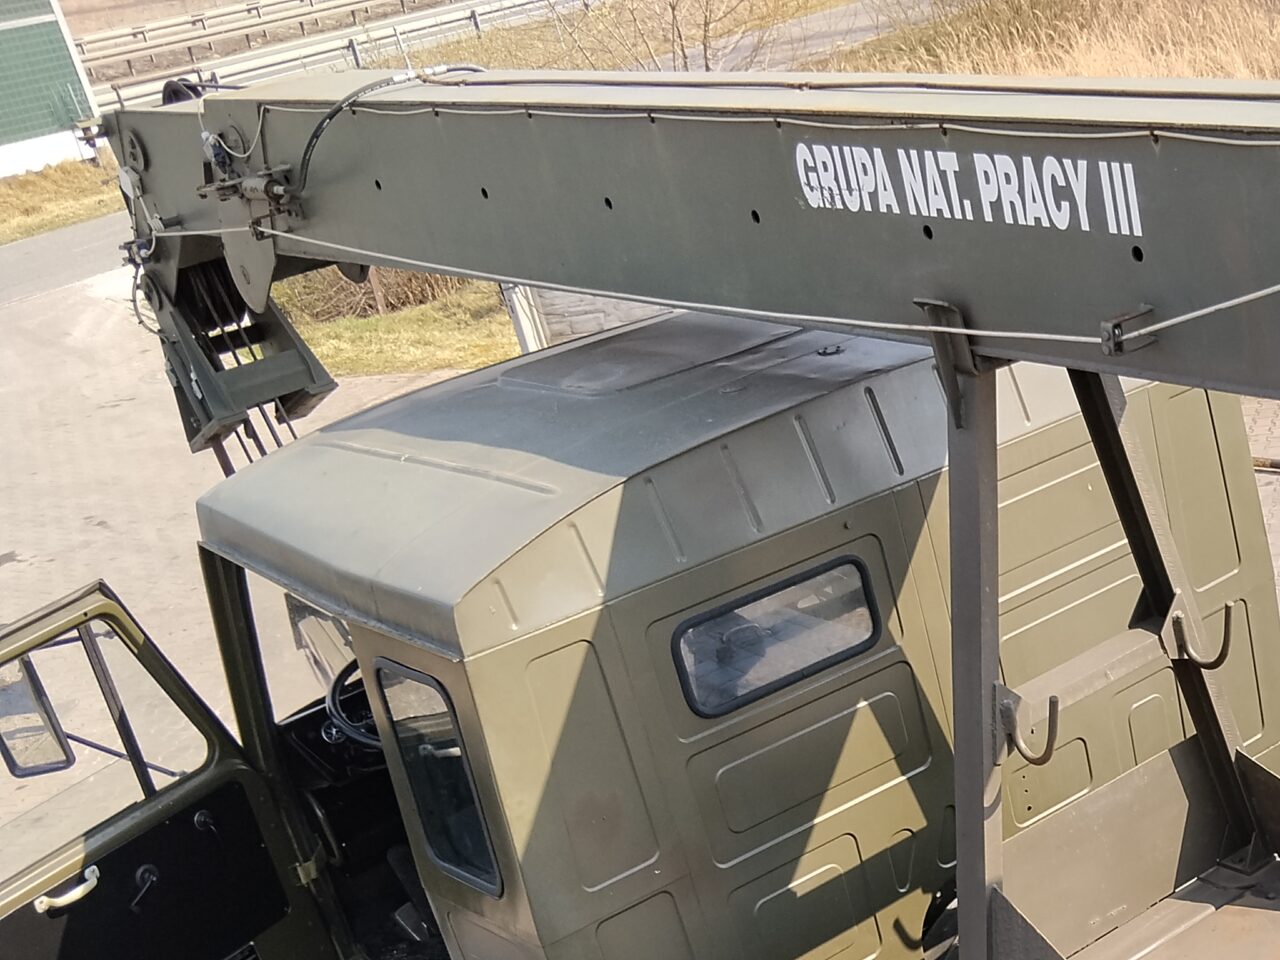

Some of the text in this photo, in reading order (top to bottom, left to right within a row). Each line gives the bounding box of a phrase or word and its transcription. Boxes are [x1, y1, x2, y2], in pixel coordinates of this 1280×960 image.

[796, 142, 1143, 237] GRUPA NAT. PRACY III
